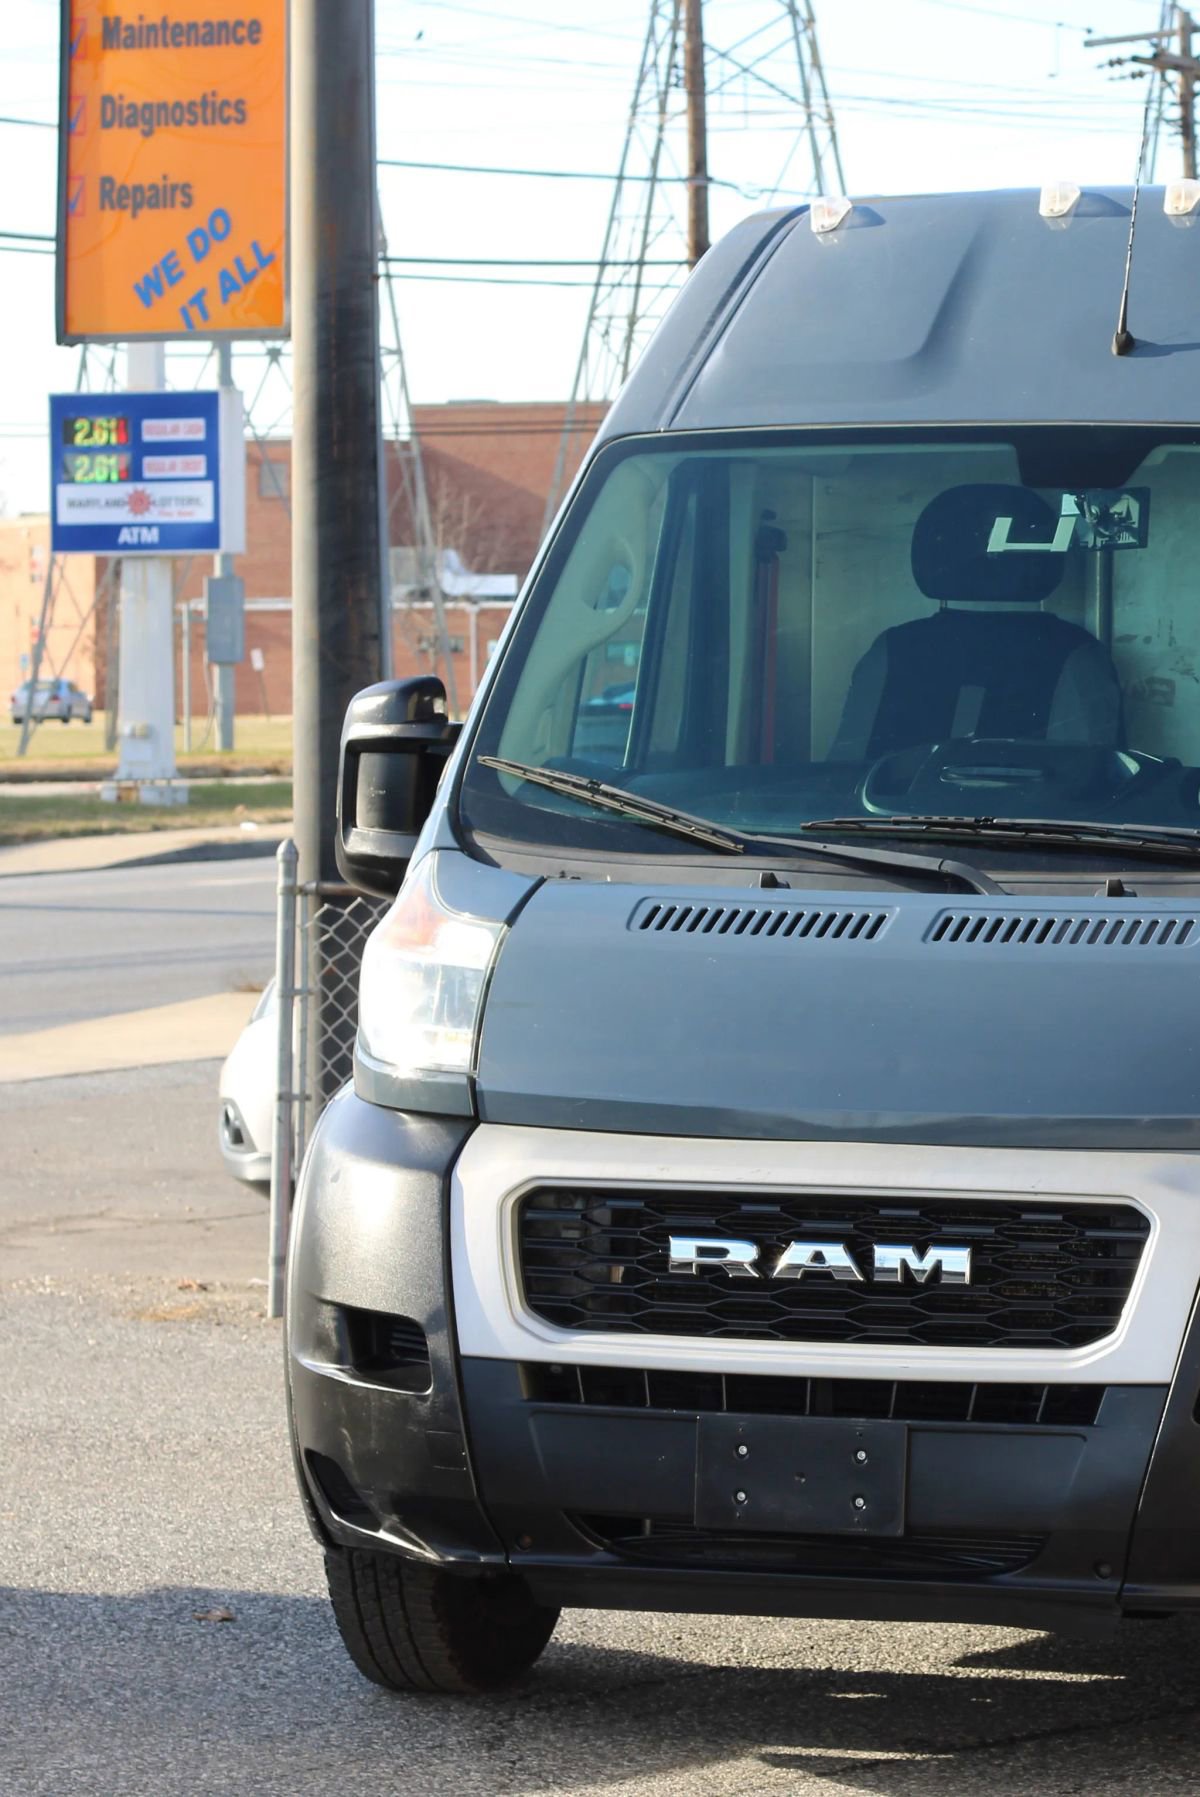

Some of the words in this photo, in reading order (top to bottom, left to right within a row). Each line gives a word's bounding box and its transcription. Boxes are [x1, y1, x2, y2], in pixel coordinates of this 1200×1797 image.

[102, 15, 262, 51] Maintenance
[100, 91, 246, 138] Diagnostics
[99, 174, 193, 219] Repairs
[133, 250, 186, 309] WE
[186, 207, 232, 263] DO
[179, 287, 210, 331] IT
[217, 240, 276, 304] ALL
[117, 526, 160, 545] ATM
[668, 1236, 972, 1284] RAM
